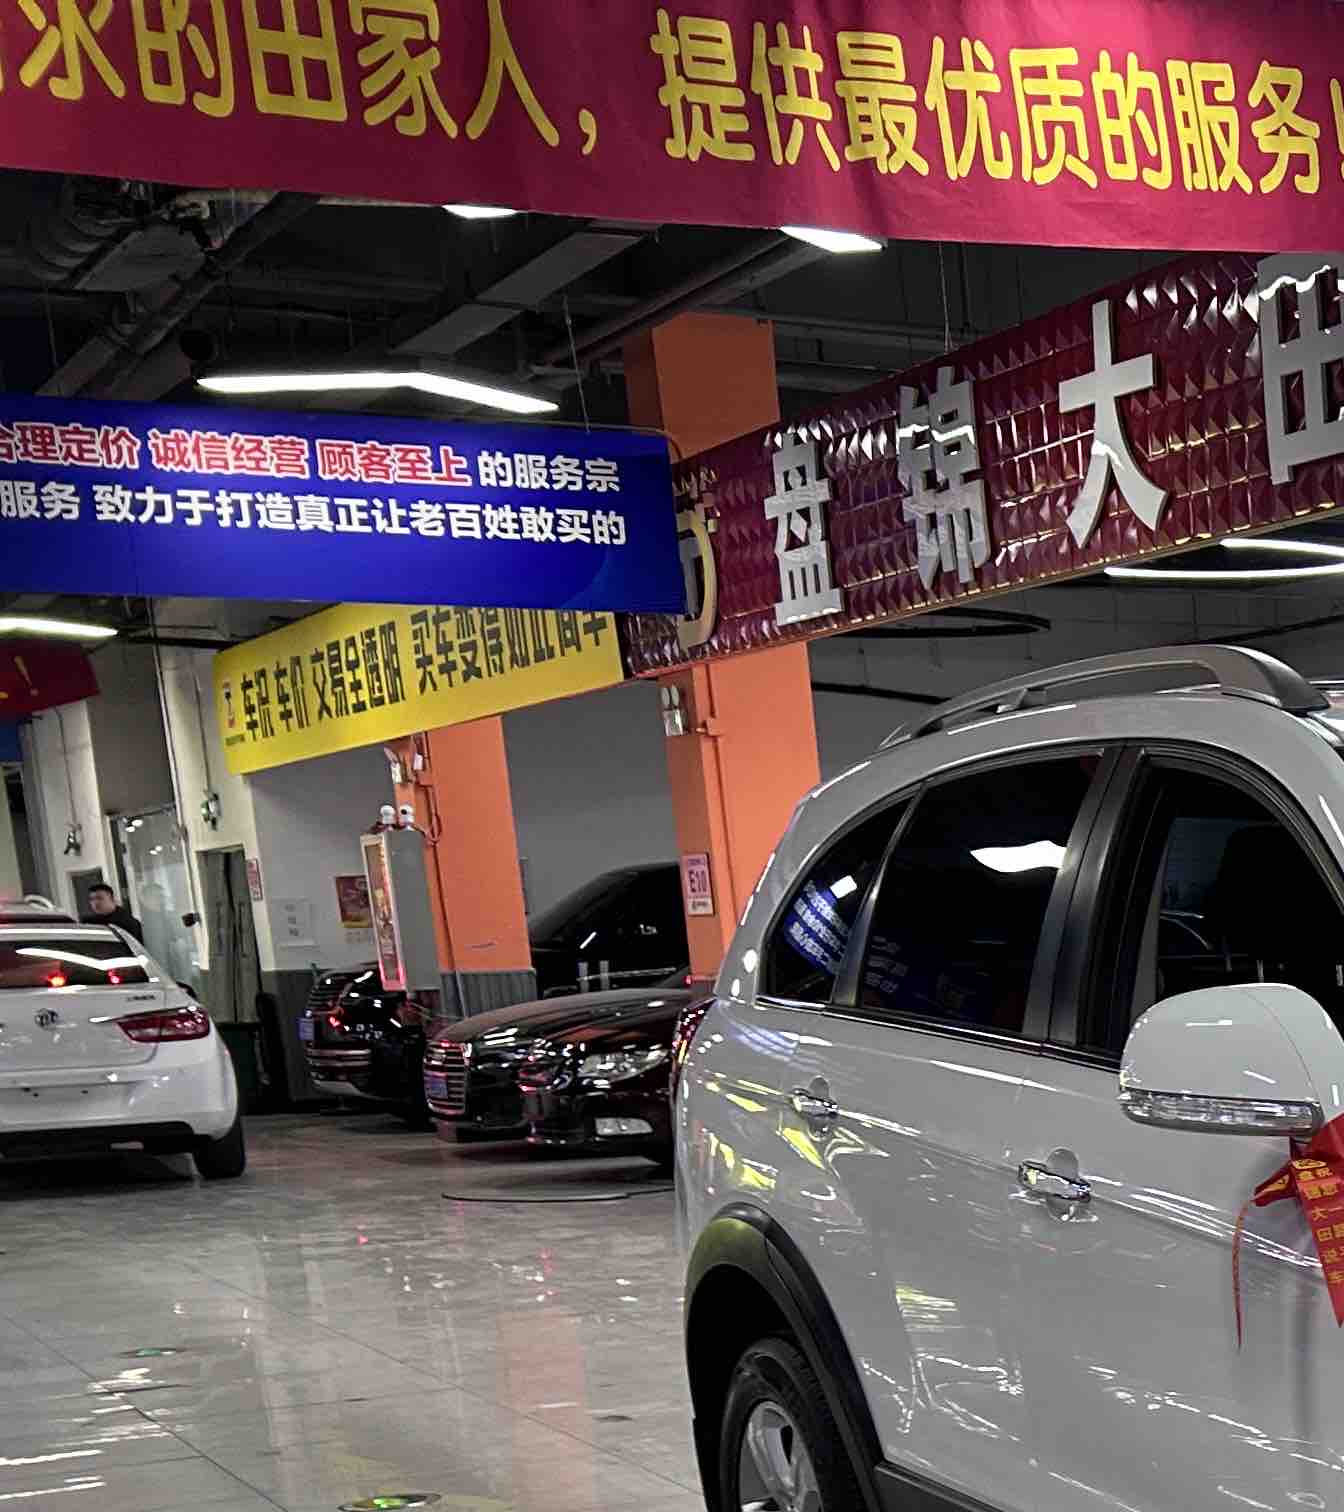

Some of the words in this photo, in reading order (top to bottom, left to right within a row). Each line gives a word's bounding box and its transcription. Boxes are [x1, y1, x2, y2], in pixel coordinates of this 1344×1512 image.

[148, 428, 310, 479] 诚信经营
[315, 438, 472, 485] 顾客至上
[477, 450, 620, 493] 的服务宗
[0, 479, 80, 520] 服务
[92, 483, 627, 546] 致力于打造真正让老百姓敢买的
